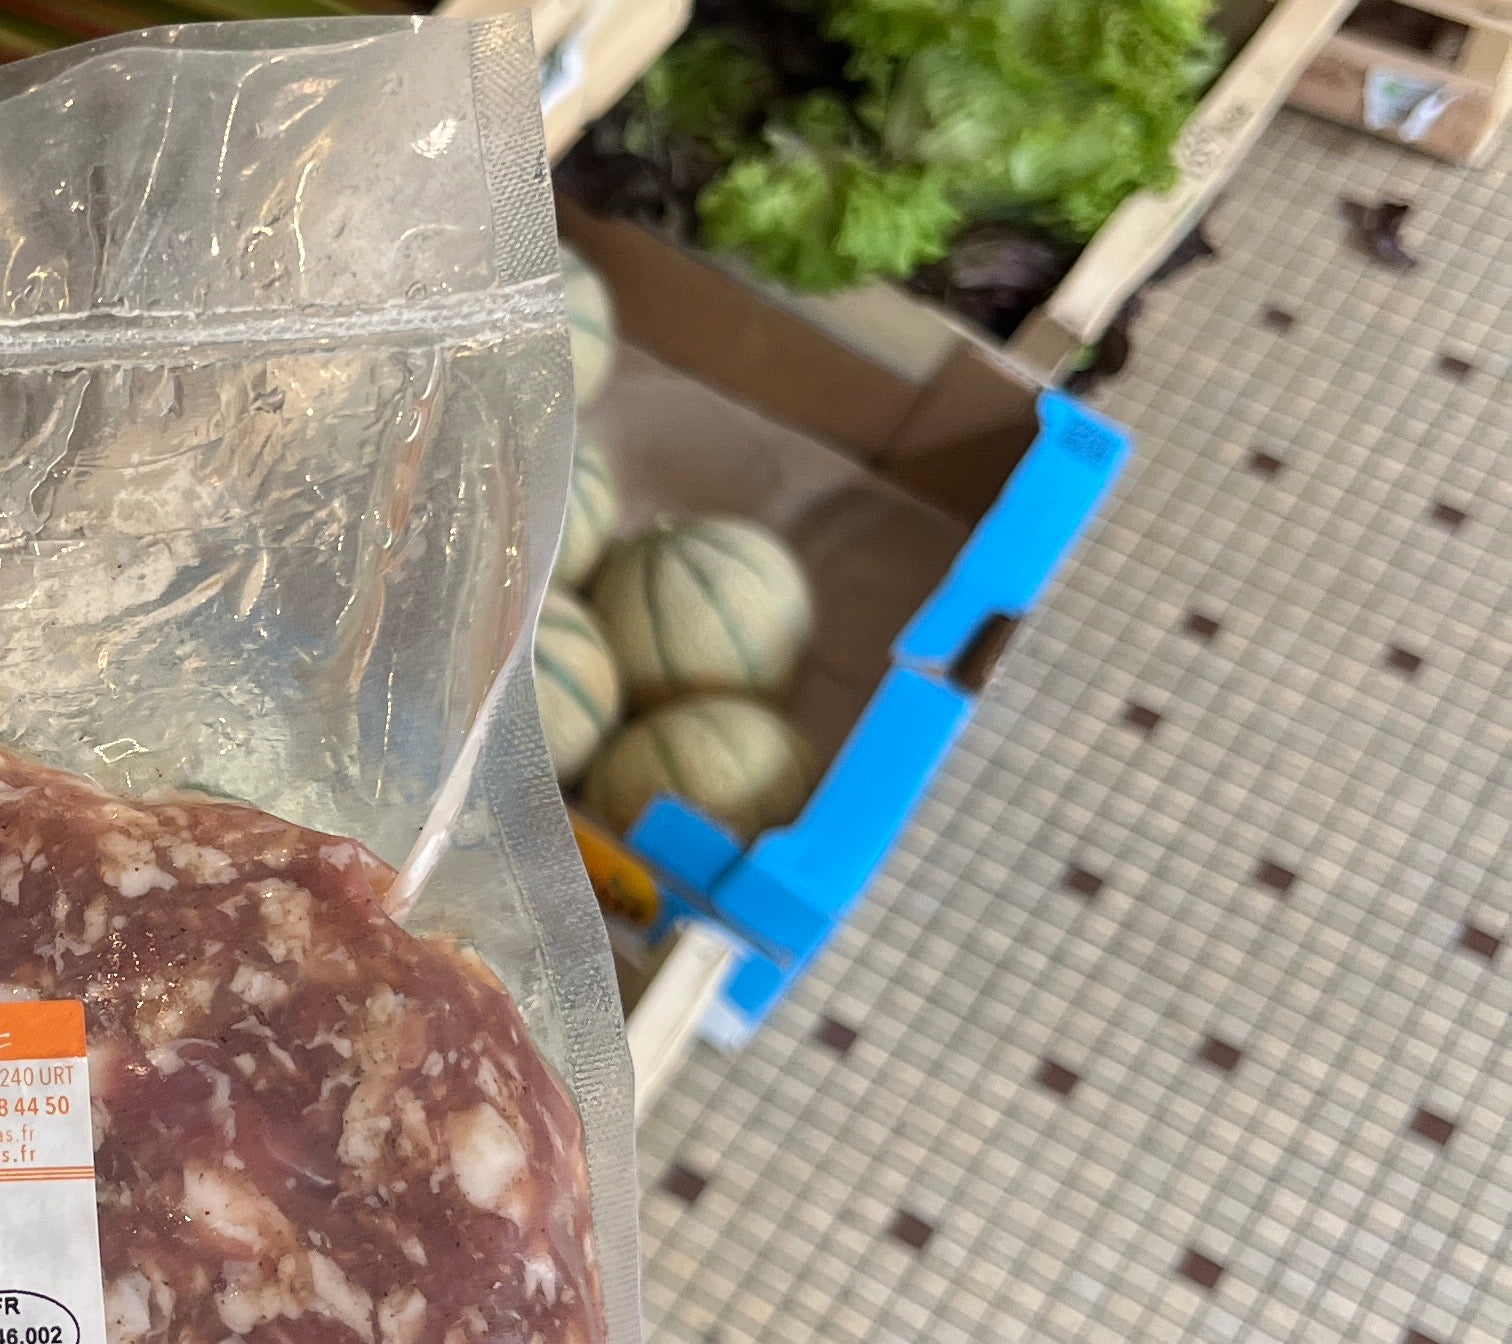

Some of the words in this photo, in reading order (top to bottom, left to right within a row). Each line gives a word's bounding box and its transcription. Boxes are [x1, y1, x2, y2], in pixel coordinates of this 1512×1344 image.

[39, 1065, 75, 1086] URT
[14, 1096, 39, 1116] 44
[45, 1094, 70, 1115] 50
